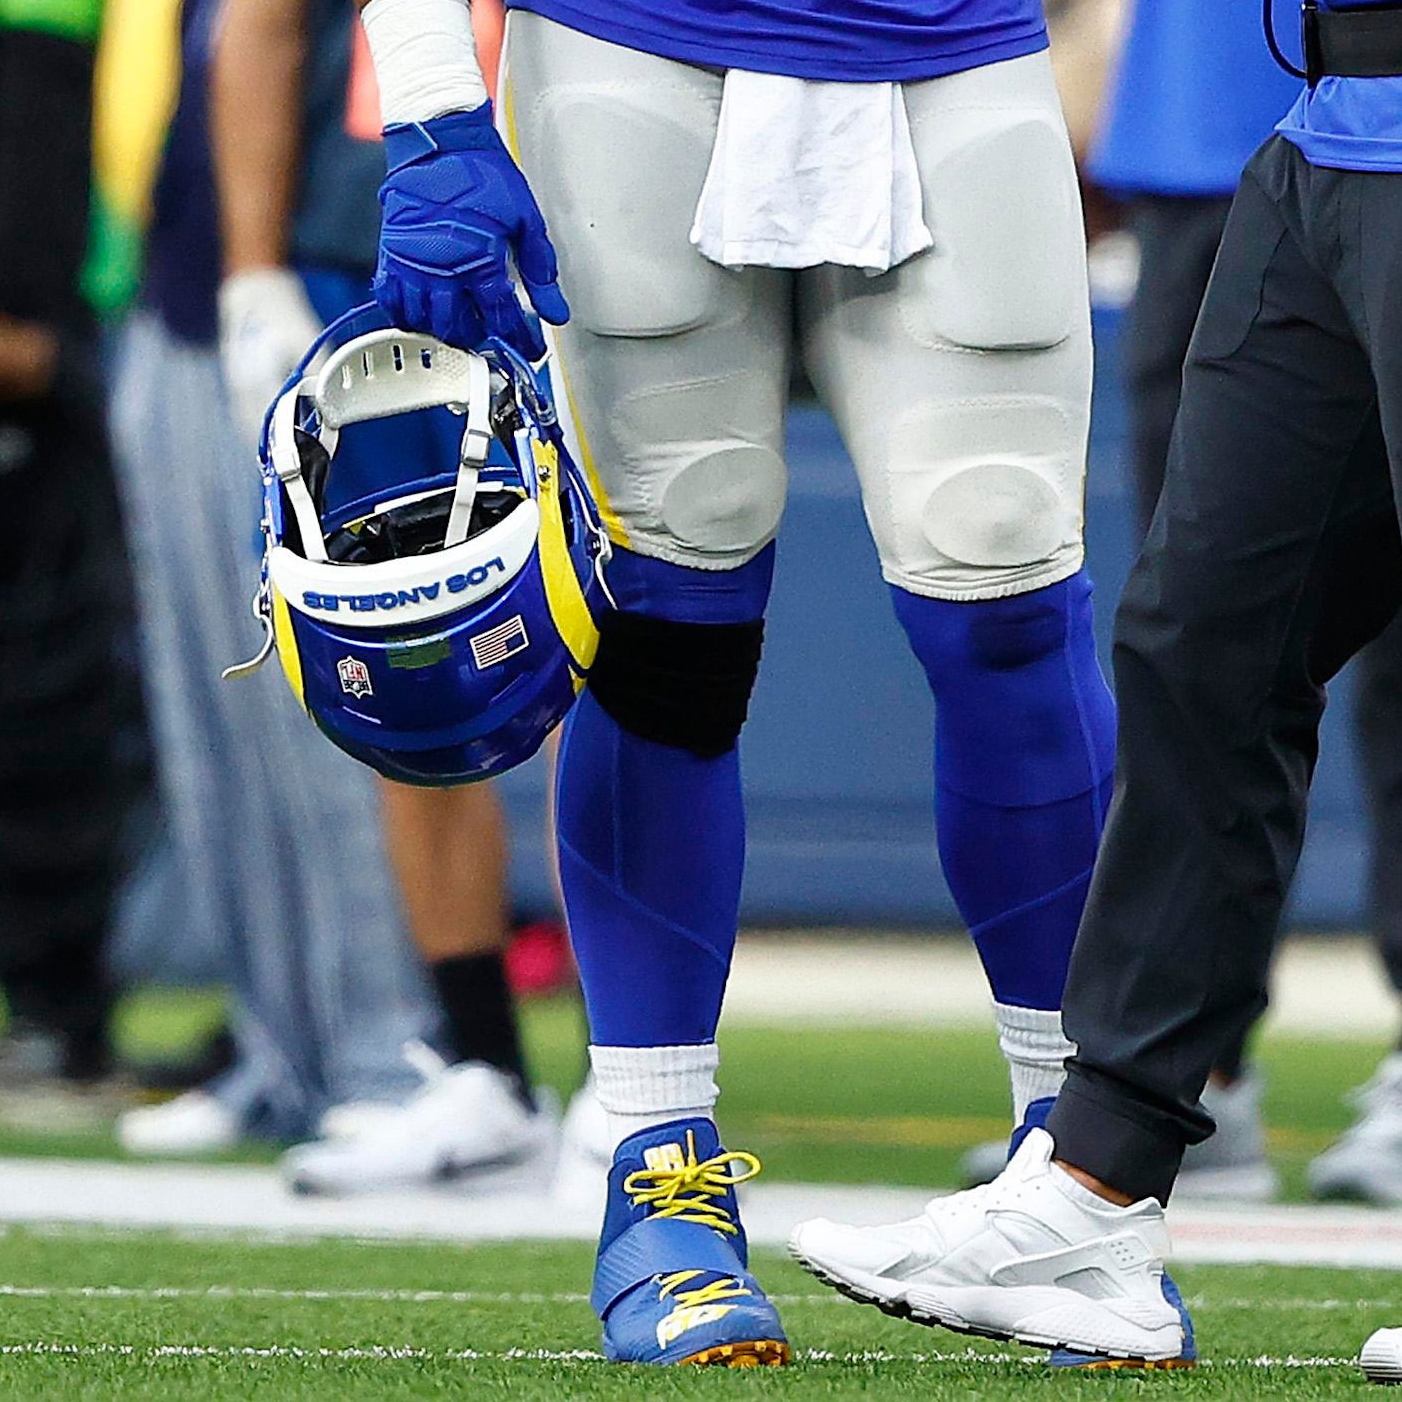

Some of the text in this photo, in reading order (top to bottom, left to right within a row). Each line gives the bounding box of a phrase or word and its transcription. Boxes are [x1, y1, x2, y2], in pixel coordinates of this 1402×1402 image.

[302, 556, 506, 613] LOS ANGELES
[341, 663, 366, 683] NFL
